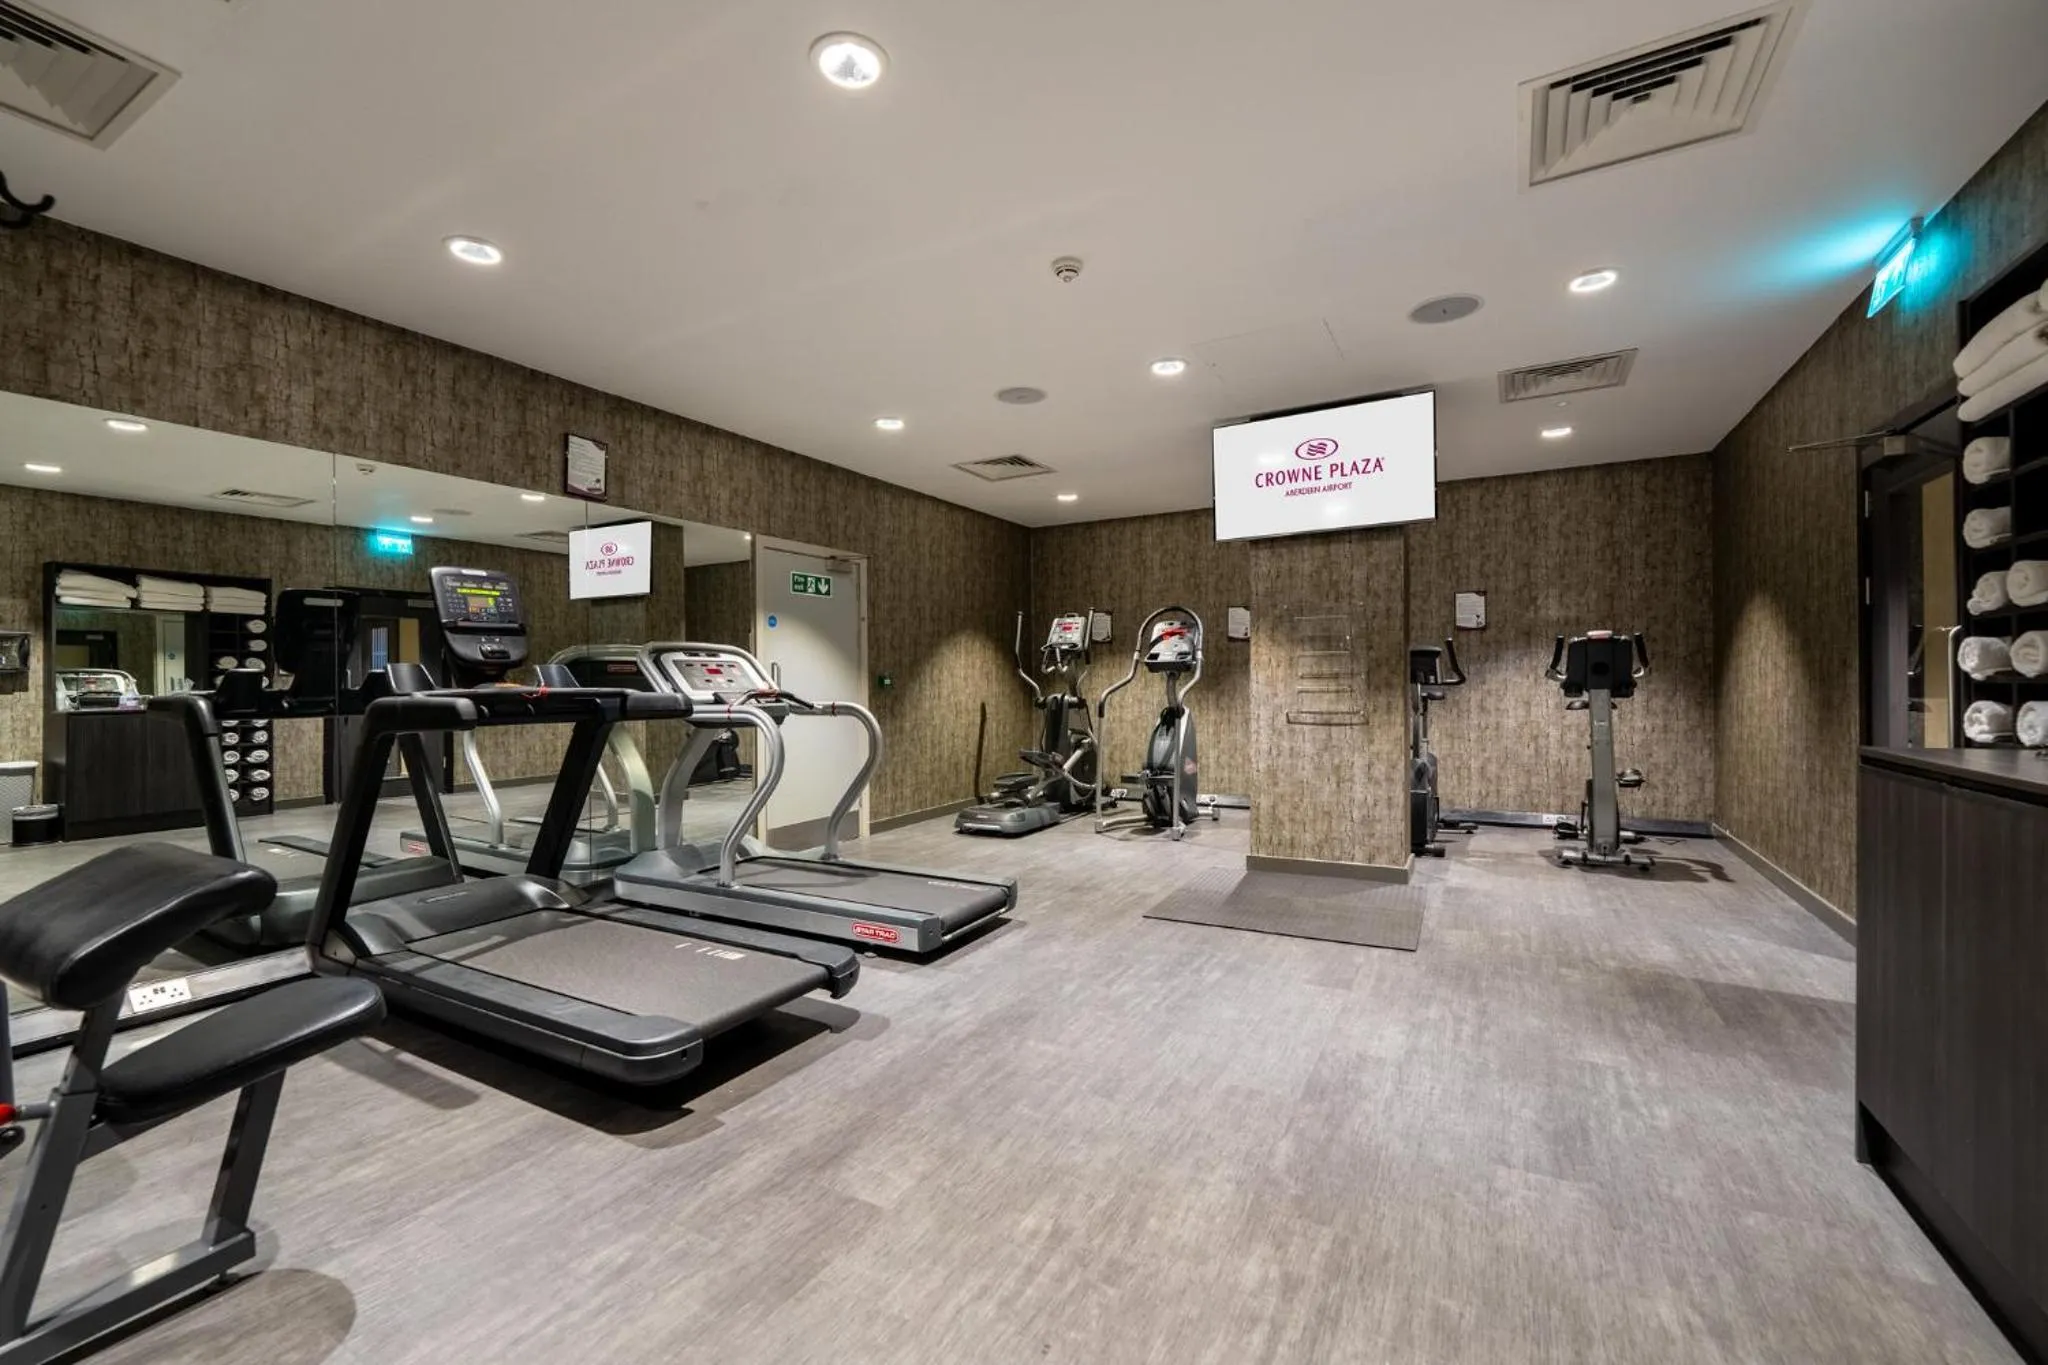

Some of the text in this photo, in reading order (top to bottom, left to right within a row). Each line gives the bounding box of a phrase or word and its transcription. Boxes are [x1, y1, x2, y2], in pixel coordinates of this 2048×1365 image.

[1255, 457, 1384, 488] CROWNE PLAZA
[1285, 482, 1353, 497] ABERDEEN AIRPORT
